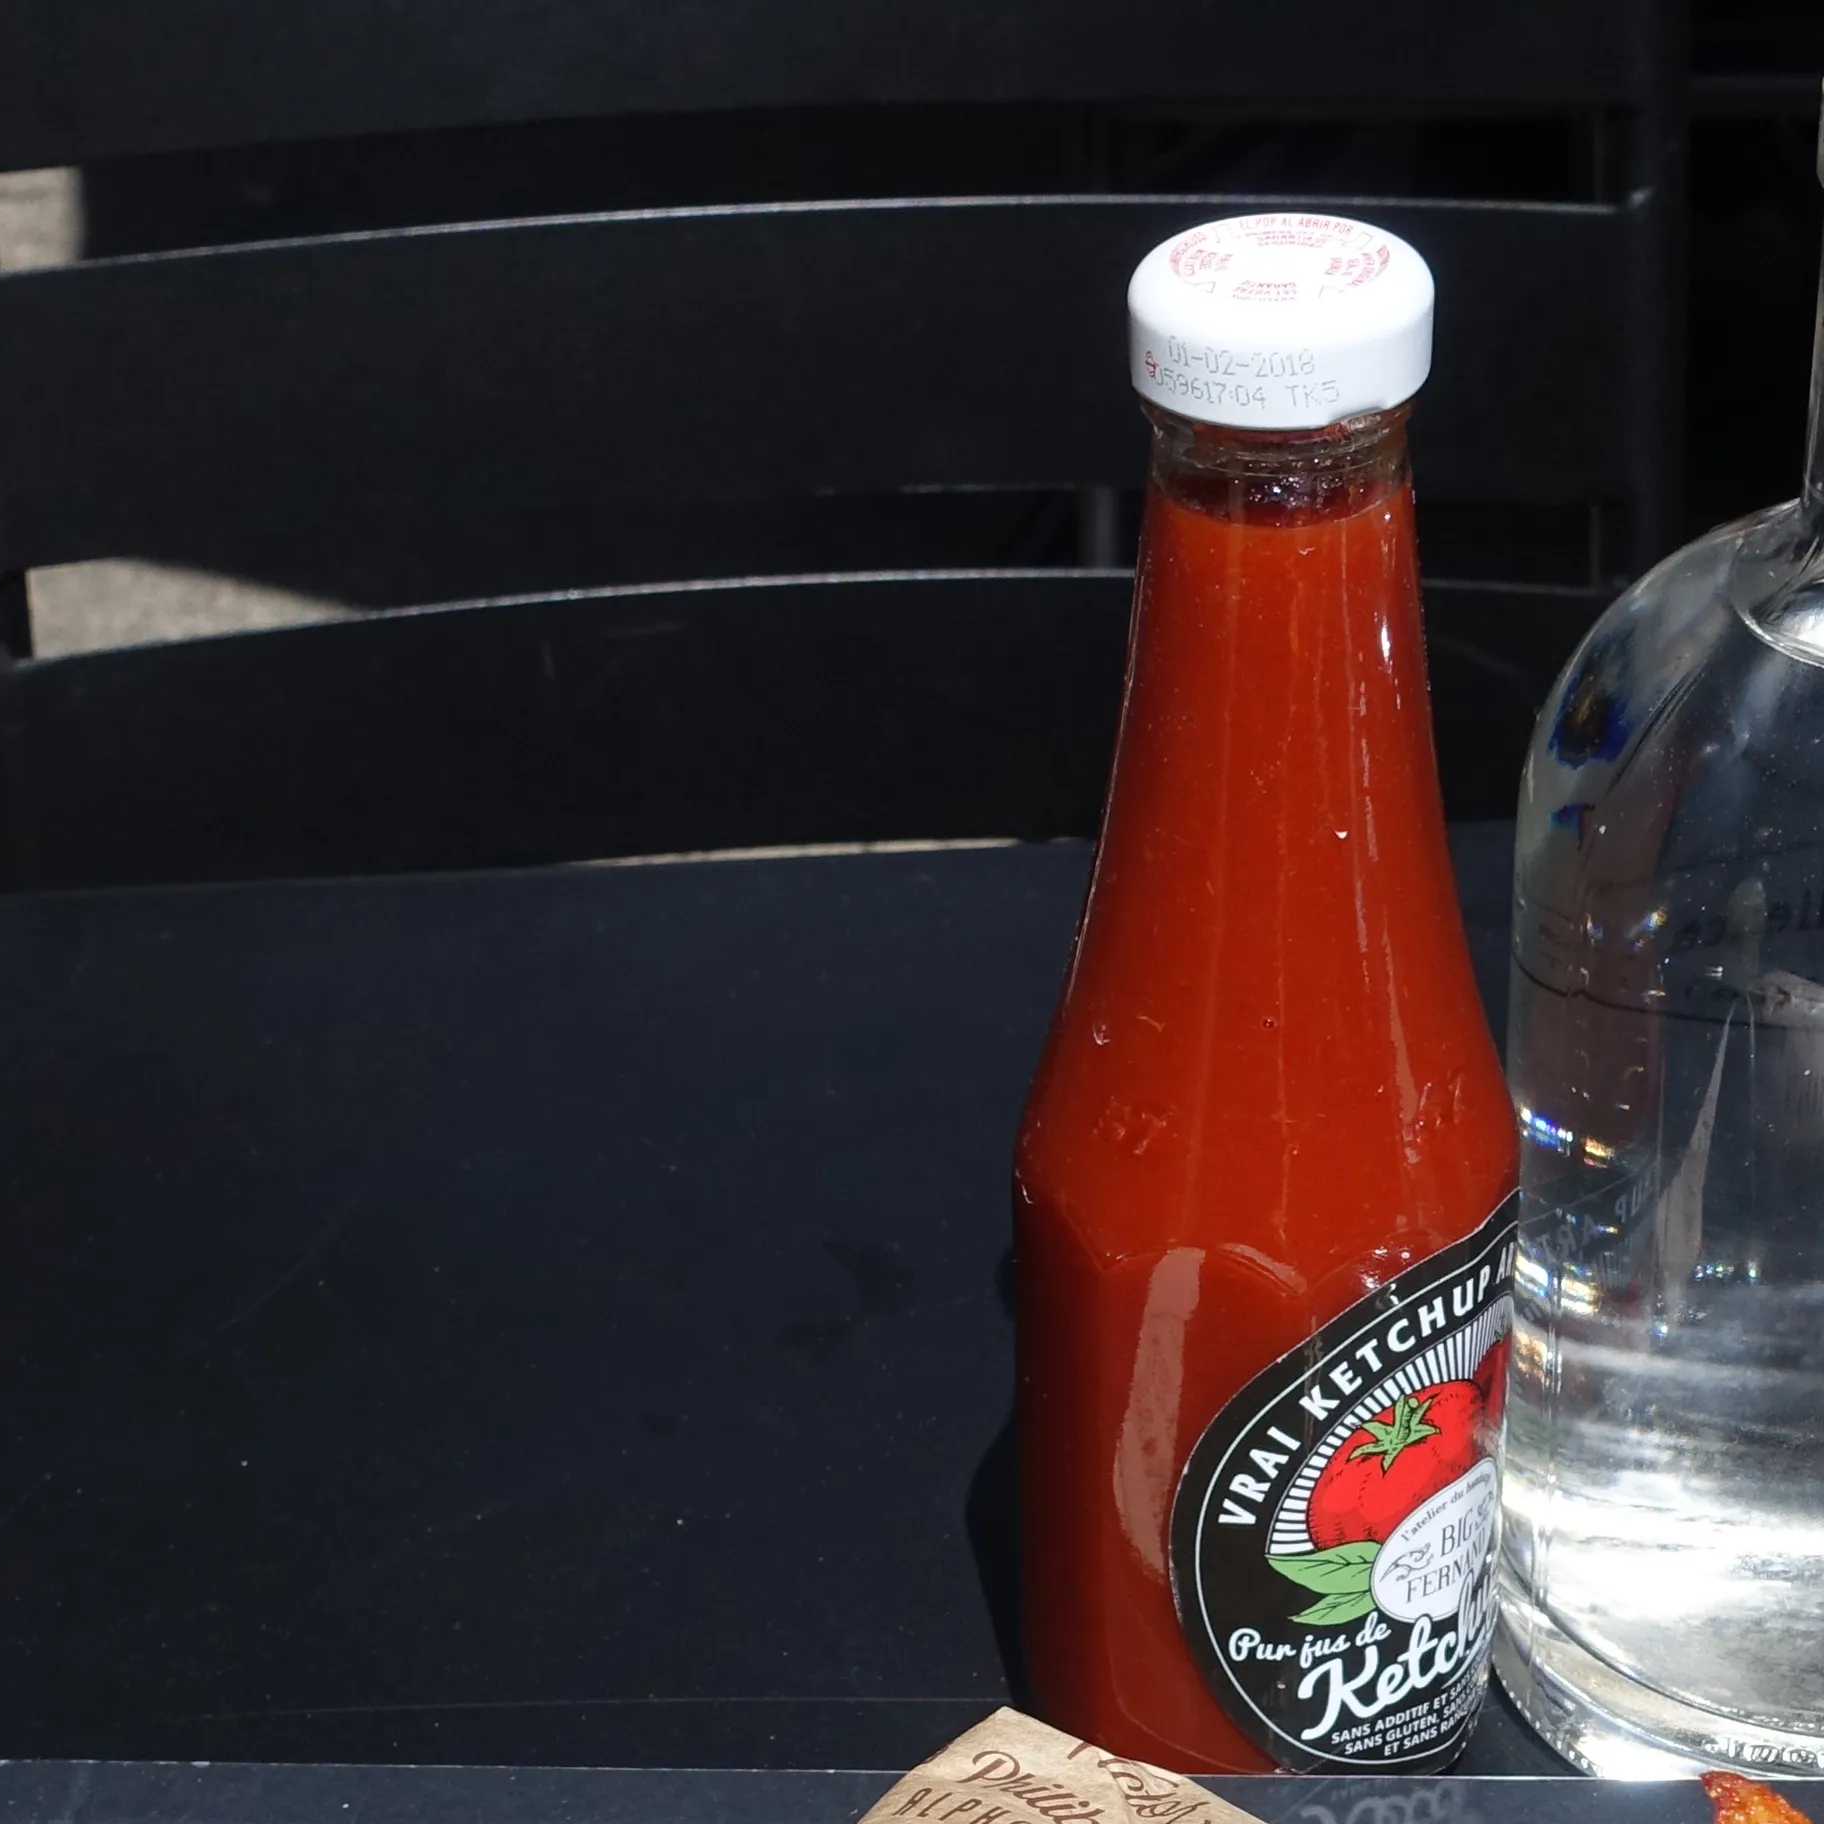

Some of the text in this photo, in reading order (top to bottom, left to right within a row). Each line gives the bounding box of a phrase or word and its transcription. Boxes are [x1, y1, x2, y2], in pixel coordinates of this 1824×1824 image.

[1297, 217, 1331, 232] ABRIR
[1333, 221, 1354, 236] POR
[1167, 334, 1316, 380] 01-02-2018
[1217, 1267, 1491, 1527] VRAI KETCHUP
[1440, 1507, 1474, 1558] BIG
[1228, 1611, 1393, 1670] Pur jus de
[1331, 1723, 1371, 1744] SANS
[1374, 1702, 1430, 1731] ADDITIF
[1433, 1694, 1447, 1710] ET
[1344, 1734, 1384, 1756] SANS
[1386, 1714, 1440, 1741] GLUTEN,
[1384, 1744, 1397, 1756] ET
[1404, 1728, 1438, 1749] SANS
